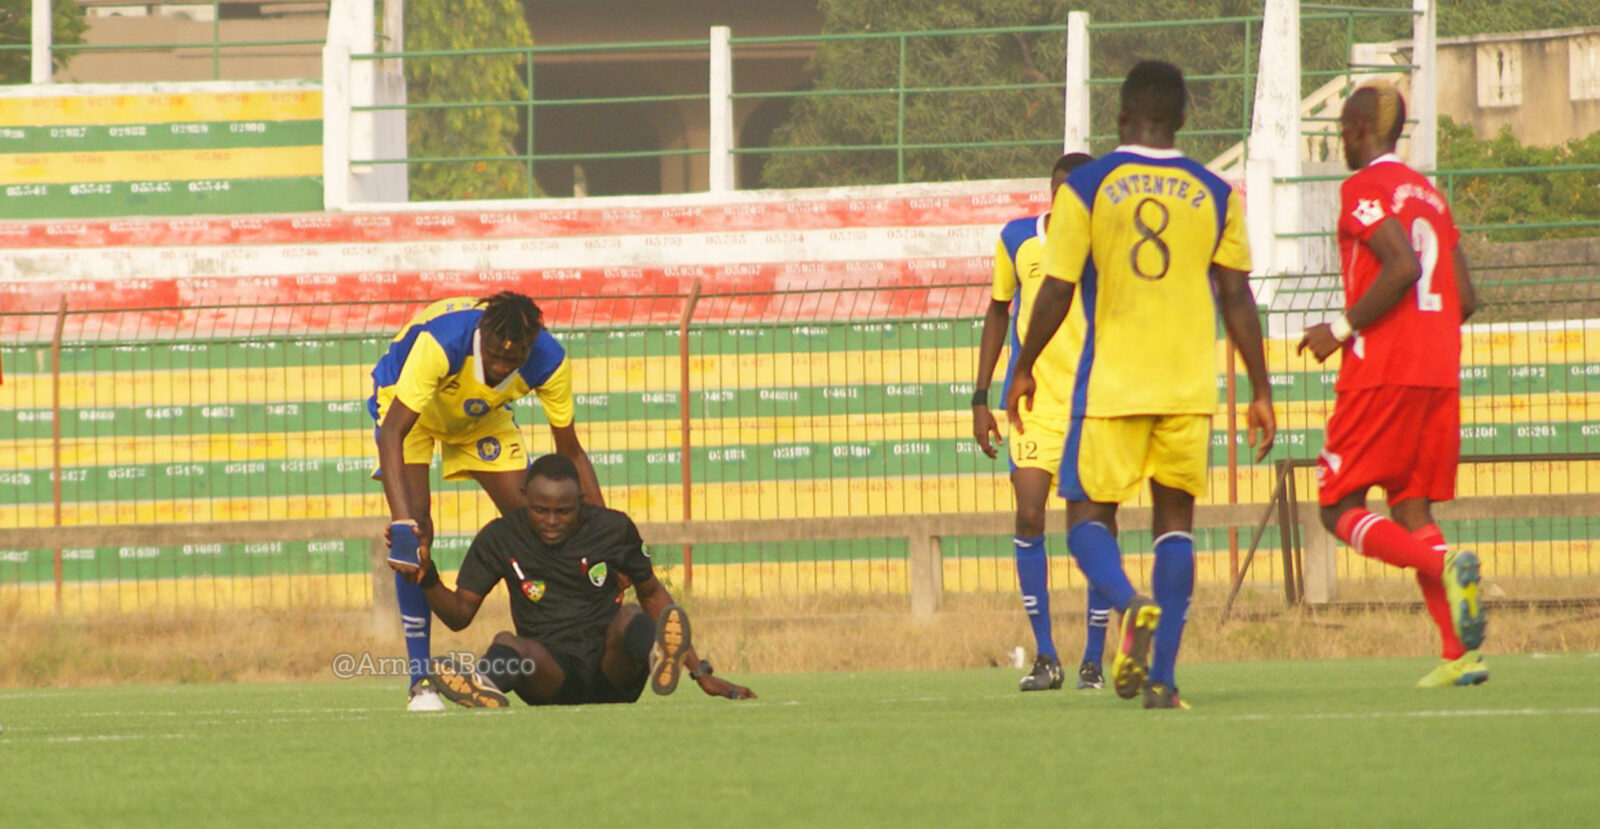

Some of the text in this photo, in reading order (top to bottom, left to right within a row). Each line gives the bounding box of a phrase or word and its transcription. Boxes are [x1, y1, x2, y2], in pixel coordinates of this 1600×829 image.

[1104, 174, 1208, 210] ENTENTE 2
[1129, 197, 1171, 281] 8
[1411, 217, 1442, 312] 2
[1571, 364, 1600, 376] 0469
[1015, 440, 1039, 461] 12
